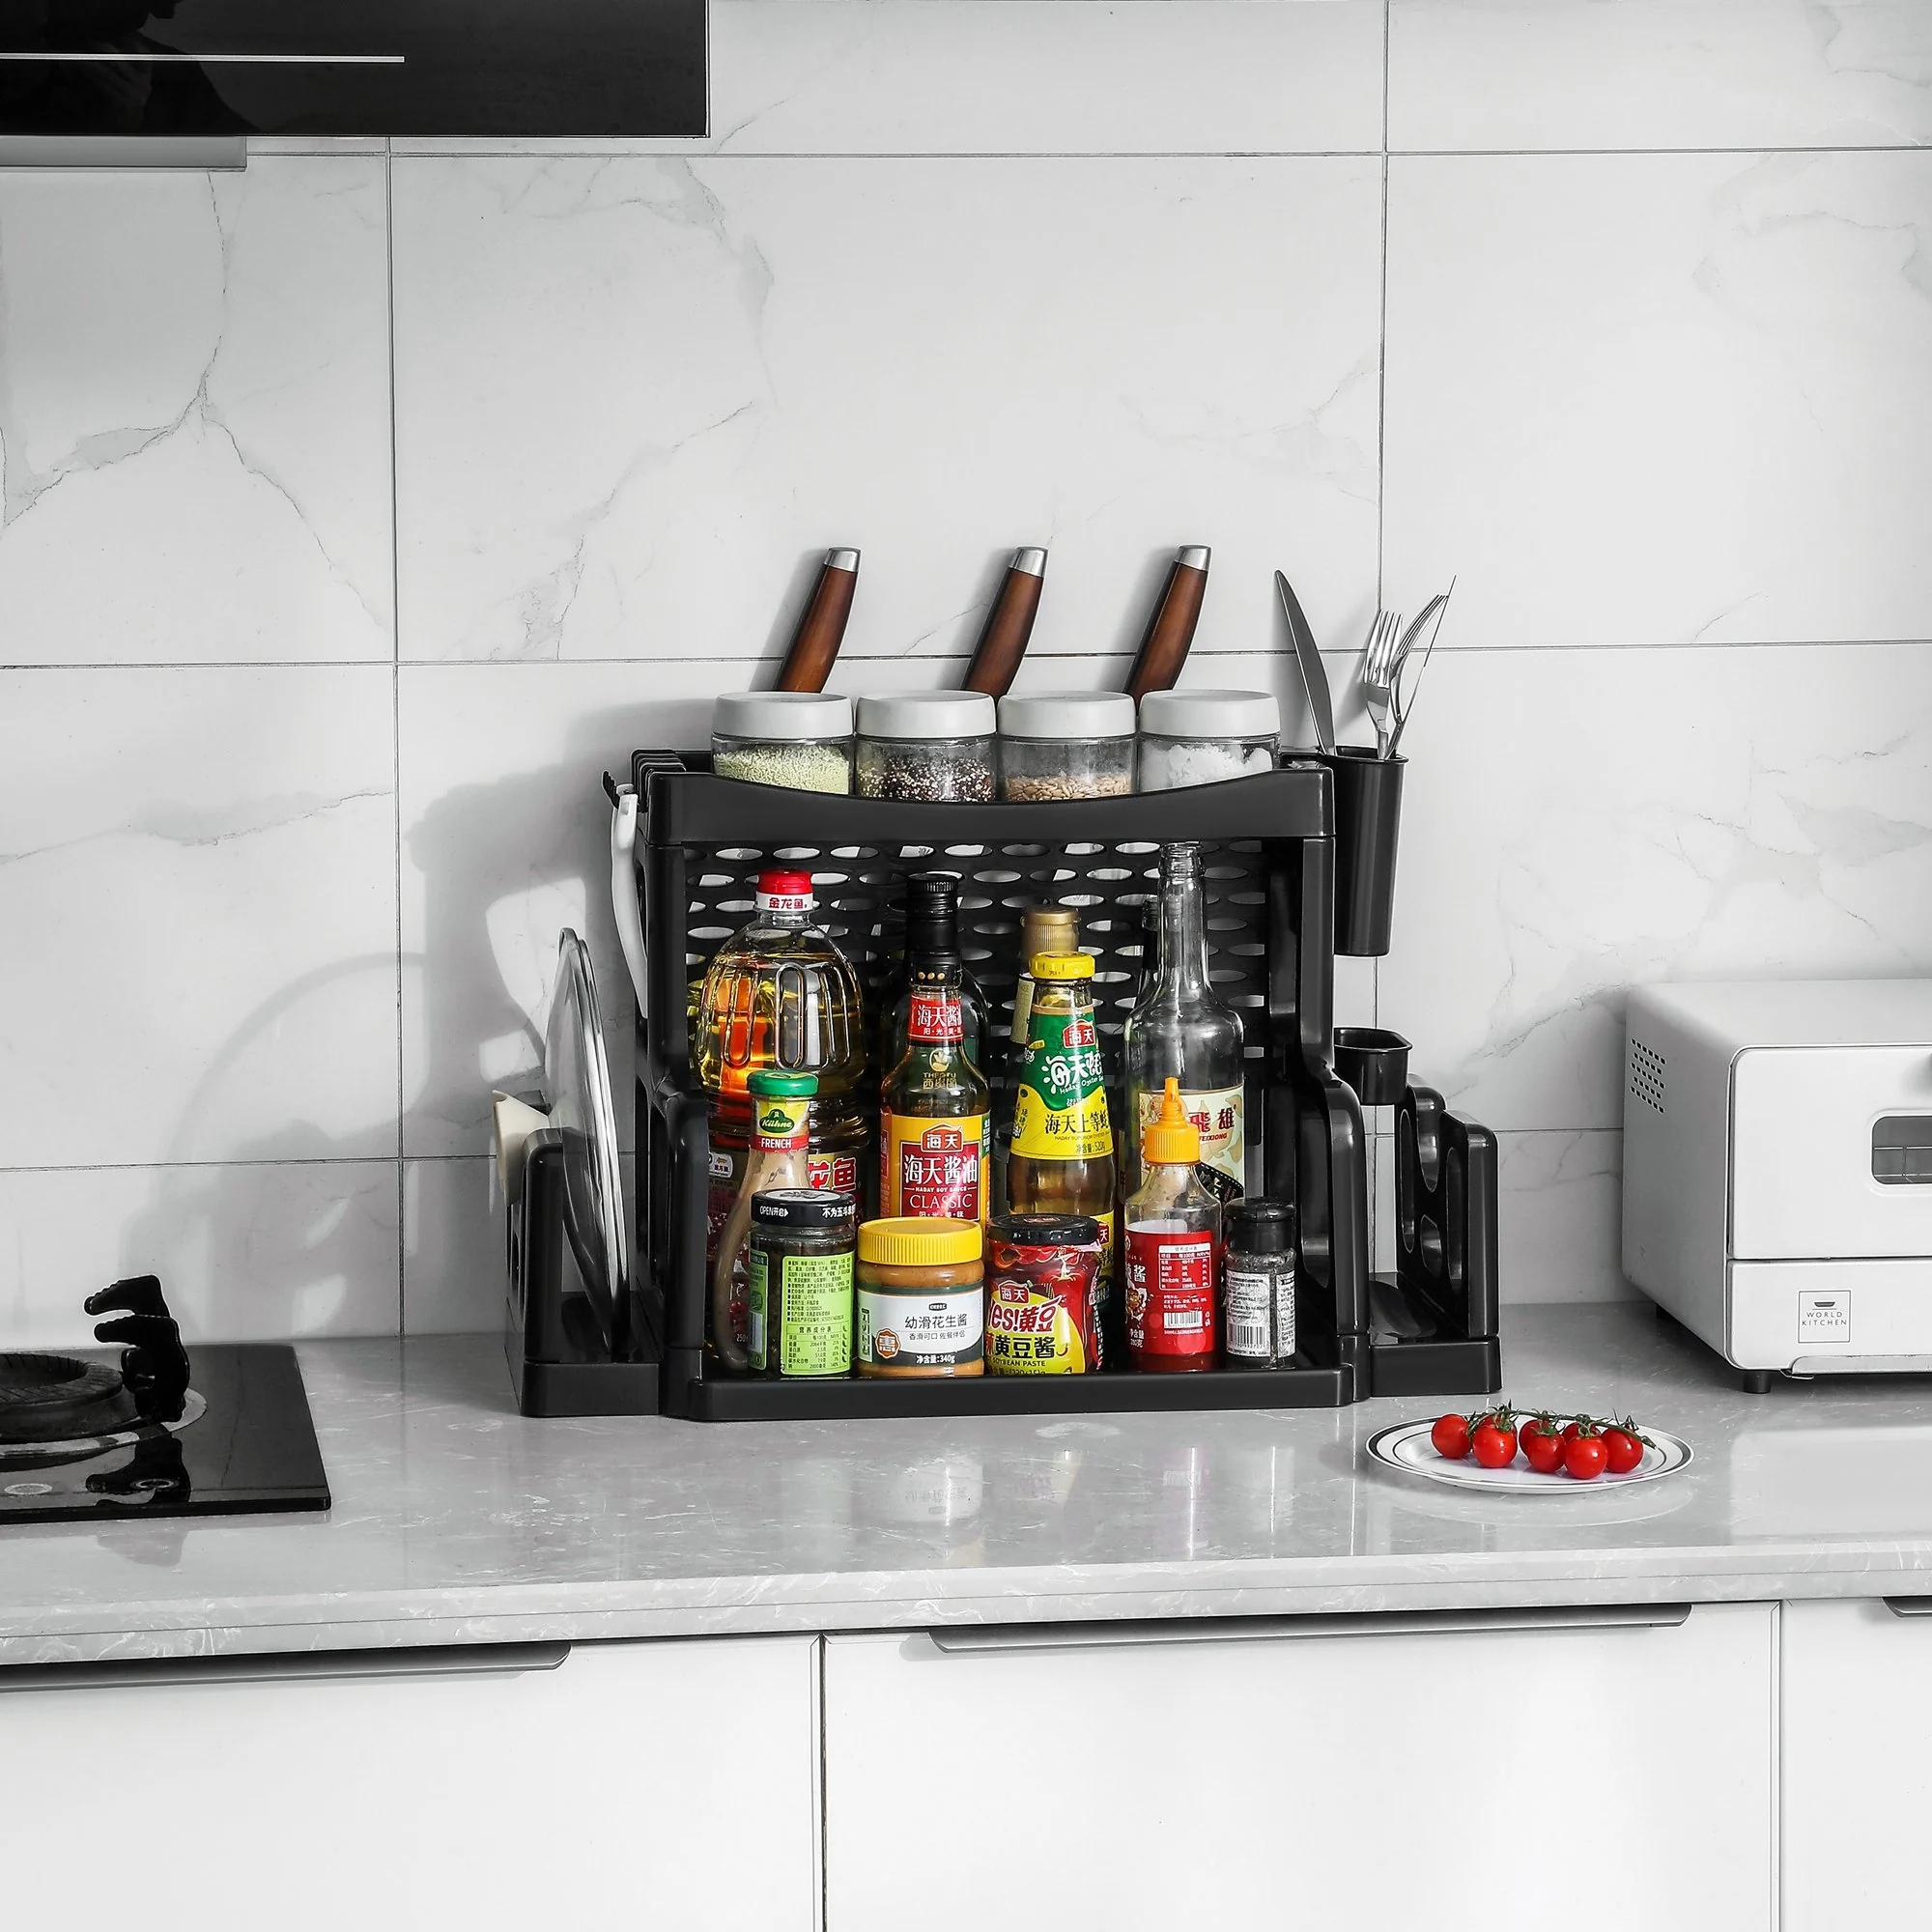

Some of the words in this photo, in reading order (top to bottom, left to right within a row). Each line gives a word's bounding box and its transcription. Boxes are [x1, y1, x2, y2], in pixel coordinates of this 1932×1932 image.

[769, 897, 804, 909] 金龙鱼
[1069, 1028, 1093, 1044] 海天
[761, 1119, 792, 1128] Kühne
[761, 1138, 791, 1149] FRENCH
[927, 1134, 958, 1149] 海天
[904, 1154, 978, 1185] 海天酱油
[910, 1194, 973, 1208] CLASSIC
[1002, 1288, 1026, 1301] 海天
[905, 1314, 967, 1329] 幼滑花生酱
[909, 1332, 937, 1341] 香滑可口
[916, 1354, 956, 1364] 净含量:340g
